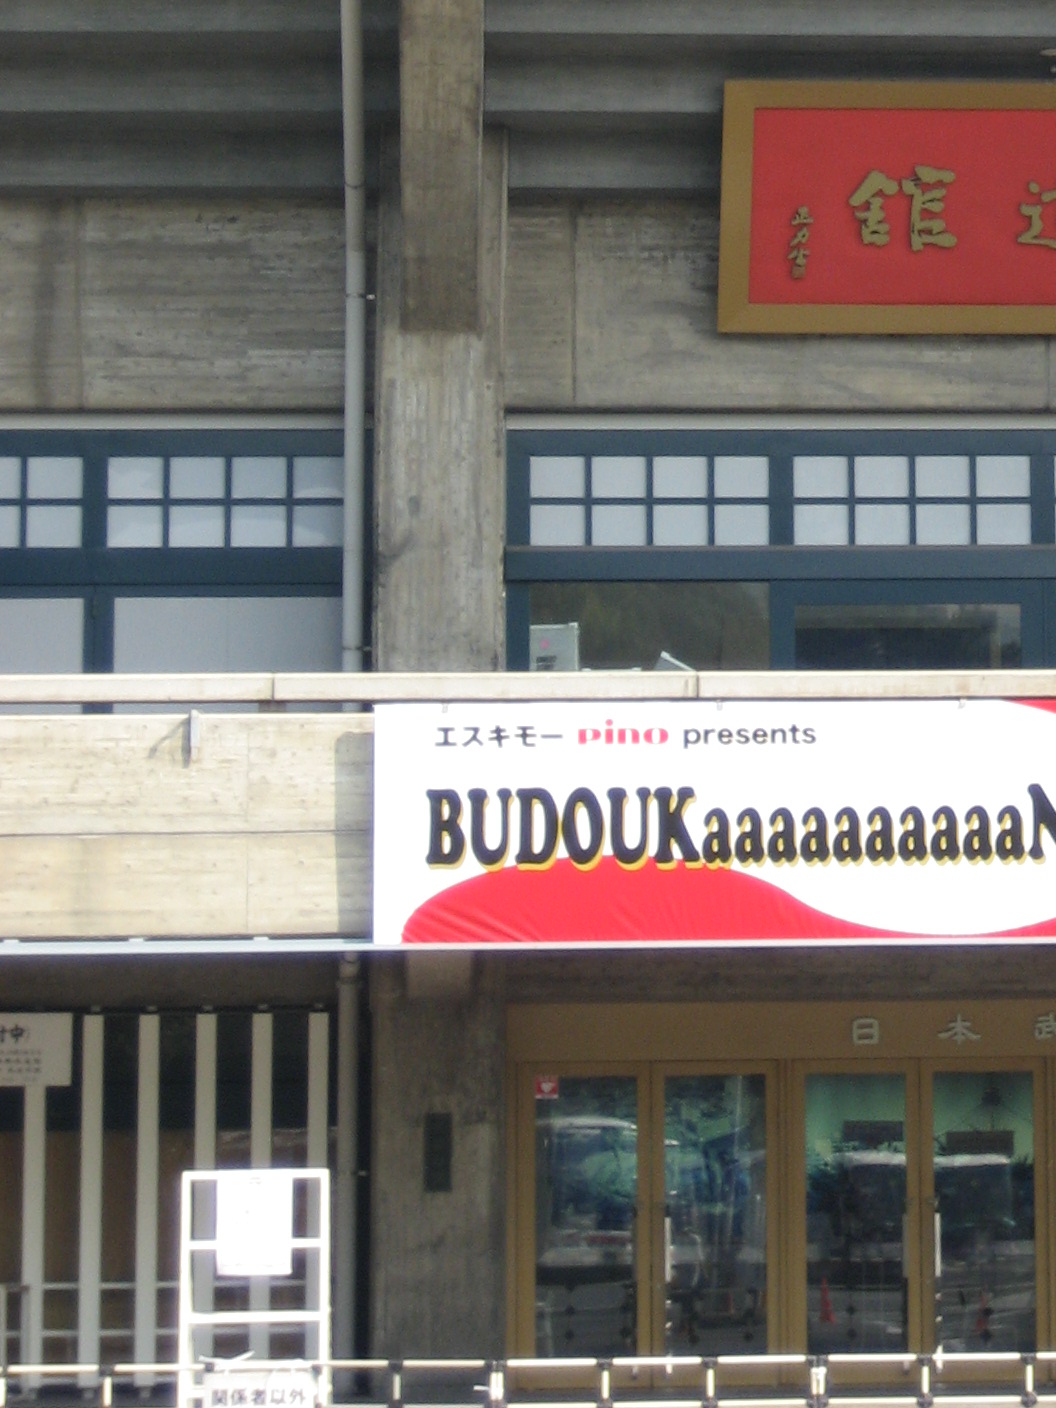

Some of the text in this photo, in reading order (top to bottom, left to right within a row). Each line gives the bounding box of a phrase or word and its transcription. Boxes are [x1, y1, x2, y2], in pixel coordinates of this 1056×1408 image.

[434, 719, 817, 748] エスキモー pino presents
